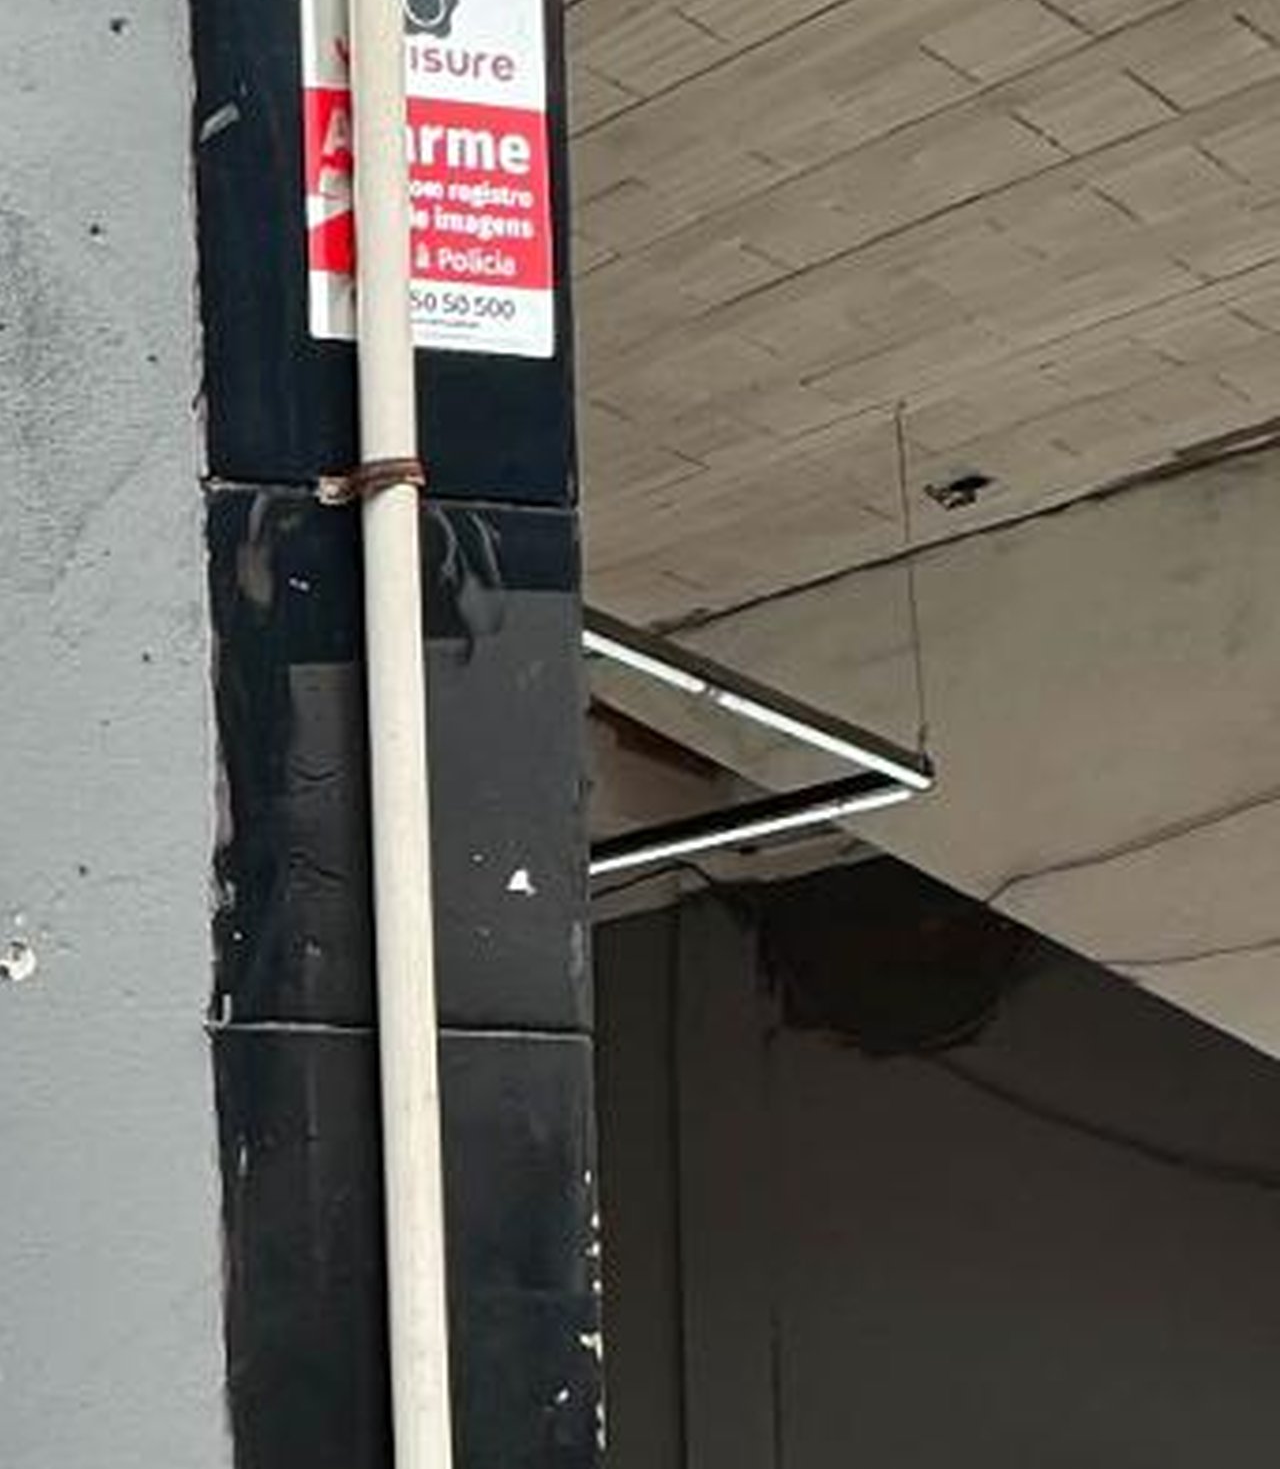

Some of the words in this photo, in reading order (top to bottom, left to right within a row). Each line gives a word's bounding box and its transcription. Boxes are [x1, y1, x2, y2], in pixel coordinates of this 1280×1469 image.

[321, 107, 531, 173] Arme
[409, 179, 444, 200] om
[434, 205, 535, 241] imagens
